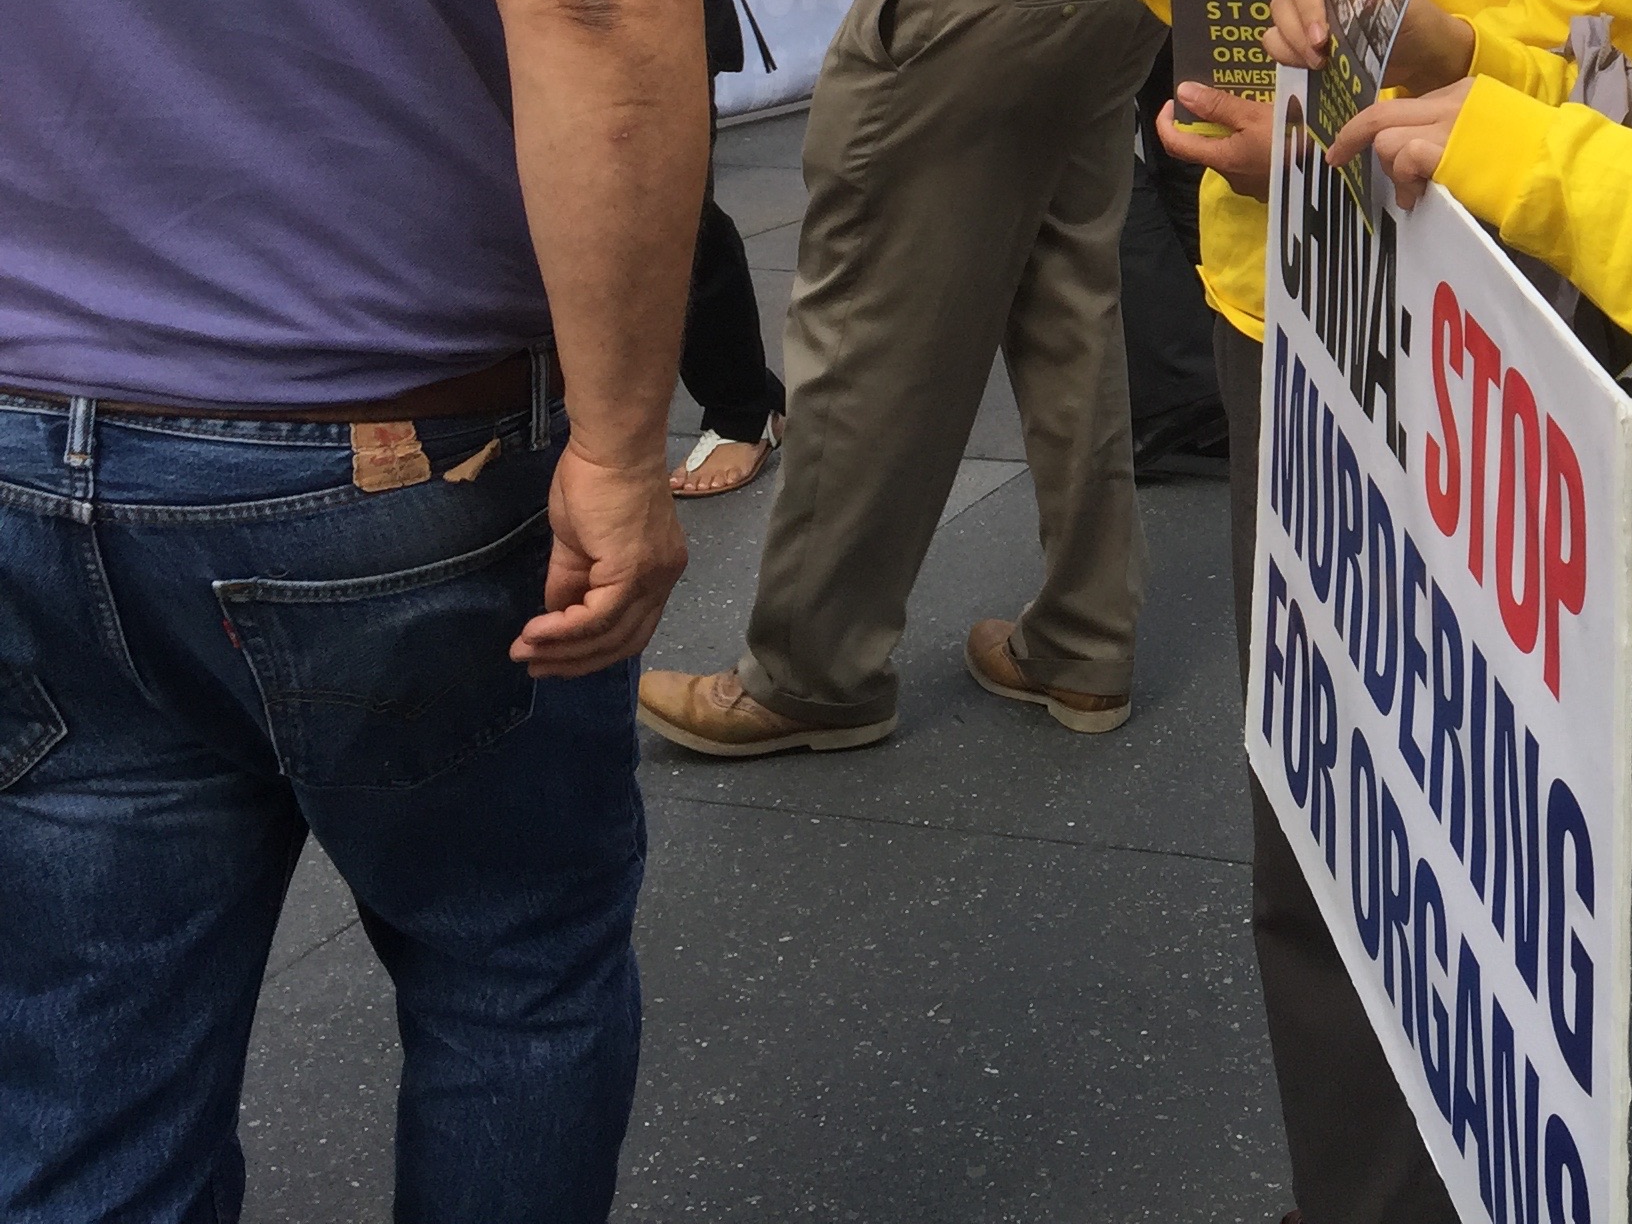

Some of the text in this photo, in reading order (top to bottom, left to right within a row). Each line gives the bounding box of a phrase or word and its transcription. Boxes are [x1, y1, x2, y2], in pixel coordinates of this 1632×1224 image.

[1206, 1, 1272, 21] STO
[1210, 24, 1267, 42] FORC
[1213, 46, 1274, 63] ORG
[1212, 68, 1277, 85] HARVEST
[1425, 280, 1587, 702] STOP
[1262, 553, 1338, 881] FOR
[1270, 323, 1595, 1097] MURDERING
